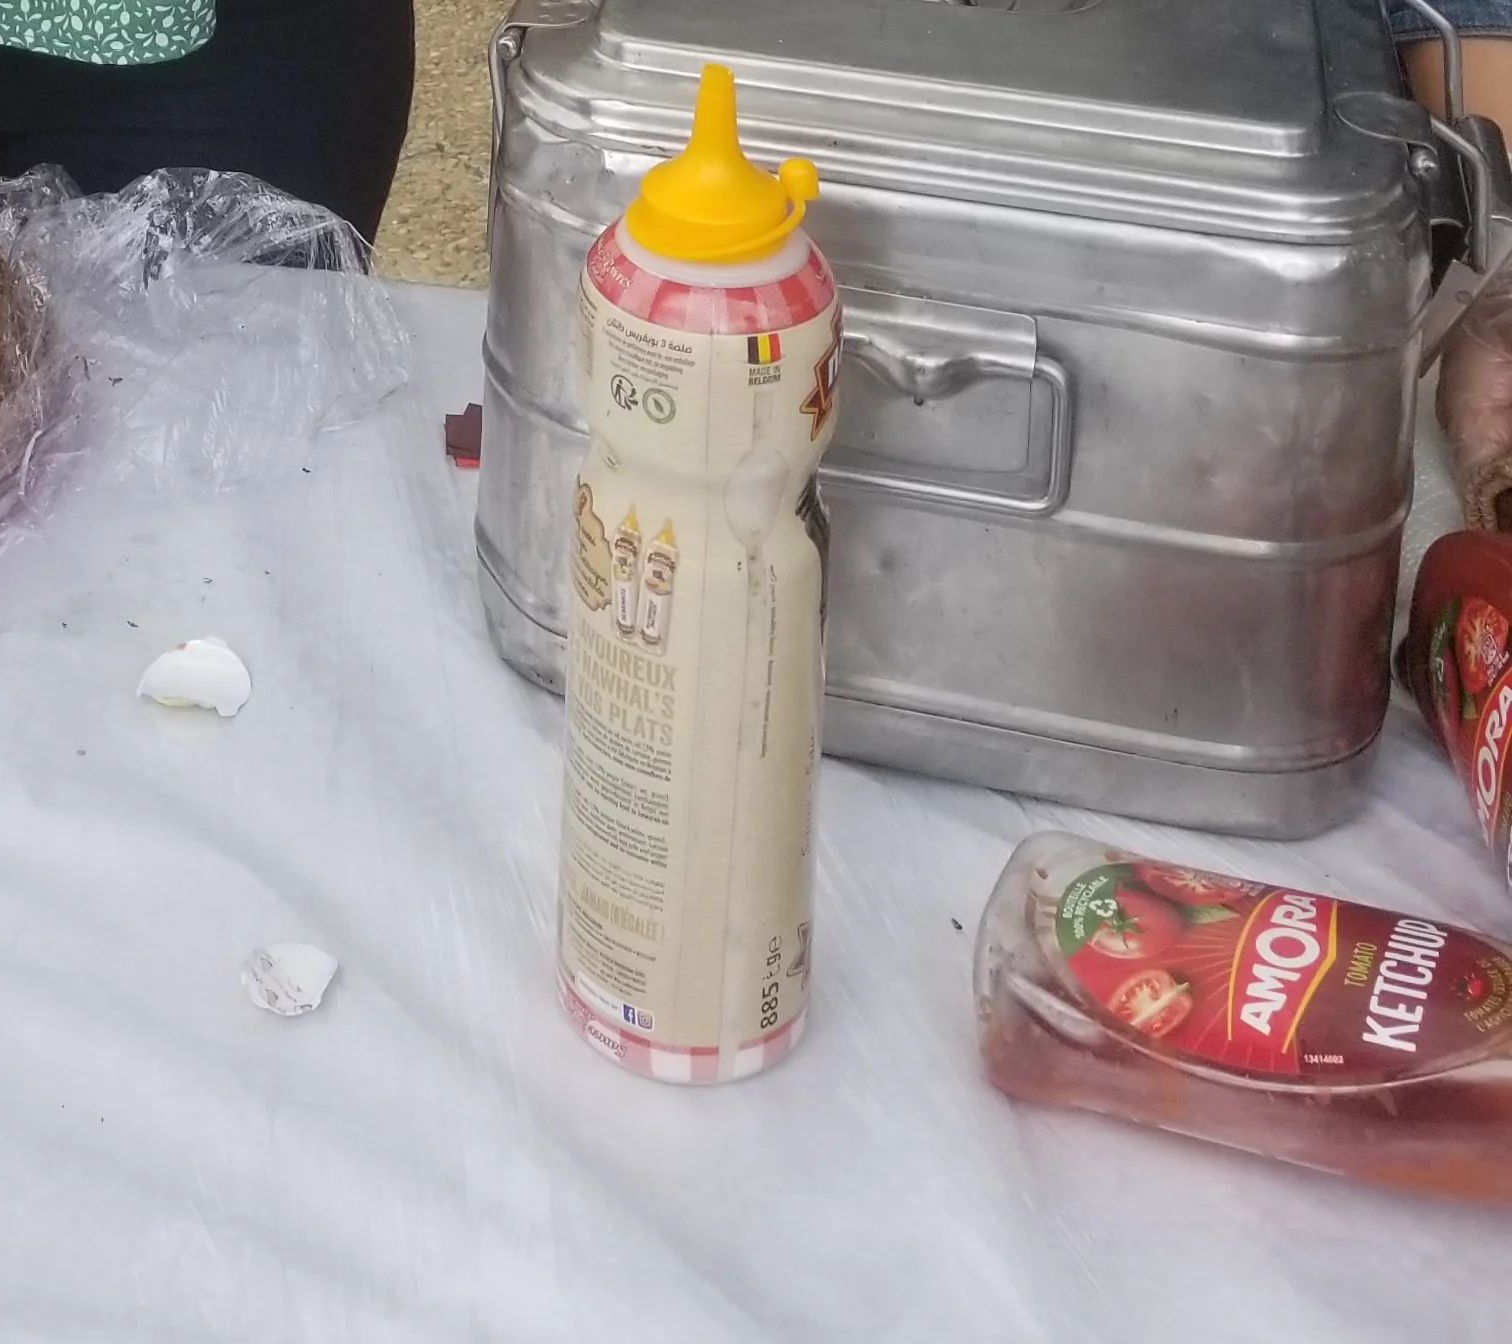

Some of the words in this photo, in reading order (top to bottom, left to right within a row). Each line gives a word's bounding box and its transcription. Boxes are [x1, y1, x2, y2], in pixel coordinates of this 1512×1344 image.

[609, 701, 673, 747] PLATS
[1074, 875, 1108, 916] RECYCLABLE
[1240, 894, 1321, 1036] AMORA
[1344, 942, 1378, 987] TOMATO
[1362, 919, 1448, 1052] KETCHUP
[760, 981, 780, 1029] 885
